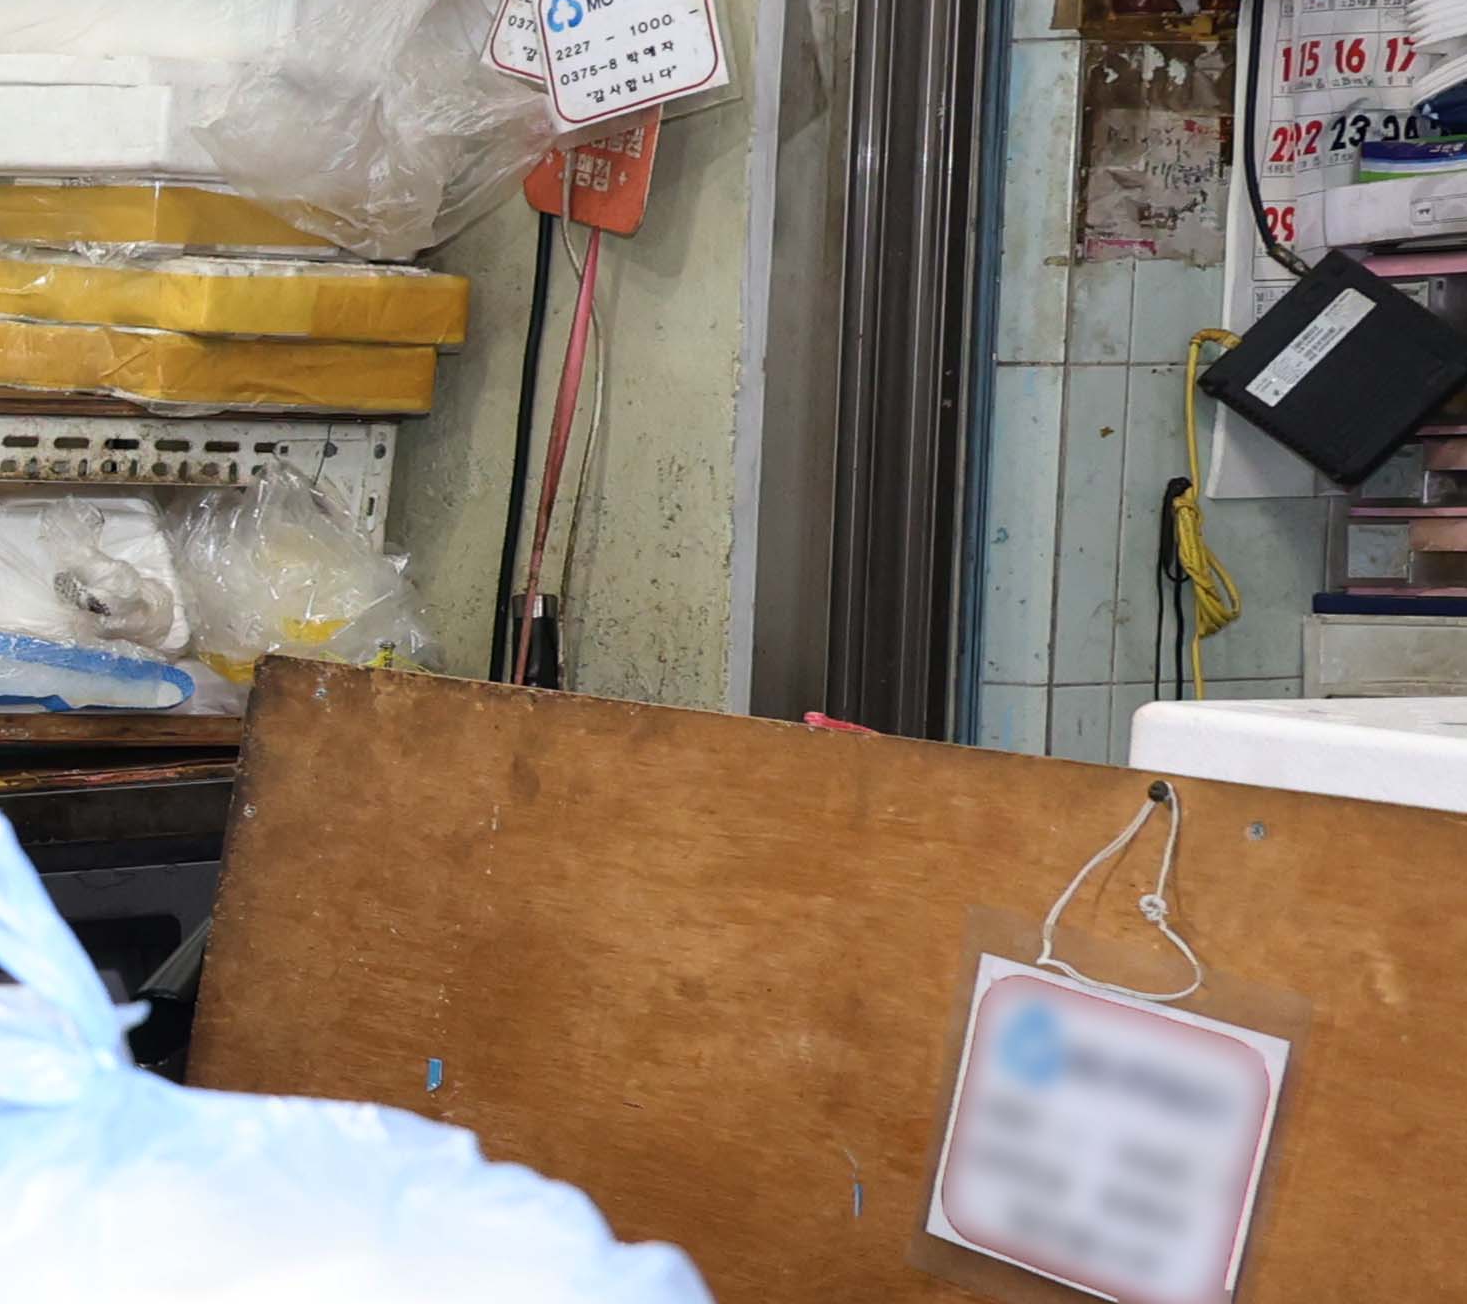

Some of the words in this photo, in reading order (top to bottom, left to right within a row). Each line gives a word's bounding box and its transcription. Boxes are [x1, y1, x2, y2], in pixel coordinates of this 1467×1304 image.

[555, 40, 591, 62] 2227
[630, 14, 673, 37] 1000
[1335, 37, 1366, 74] 16
[1385, 36, 1417, 73] 17
[559, 58, 618, 86] 0375-8
[1329, 114, 1371, 152] 23
